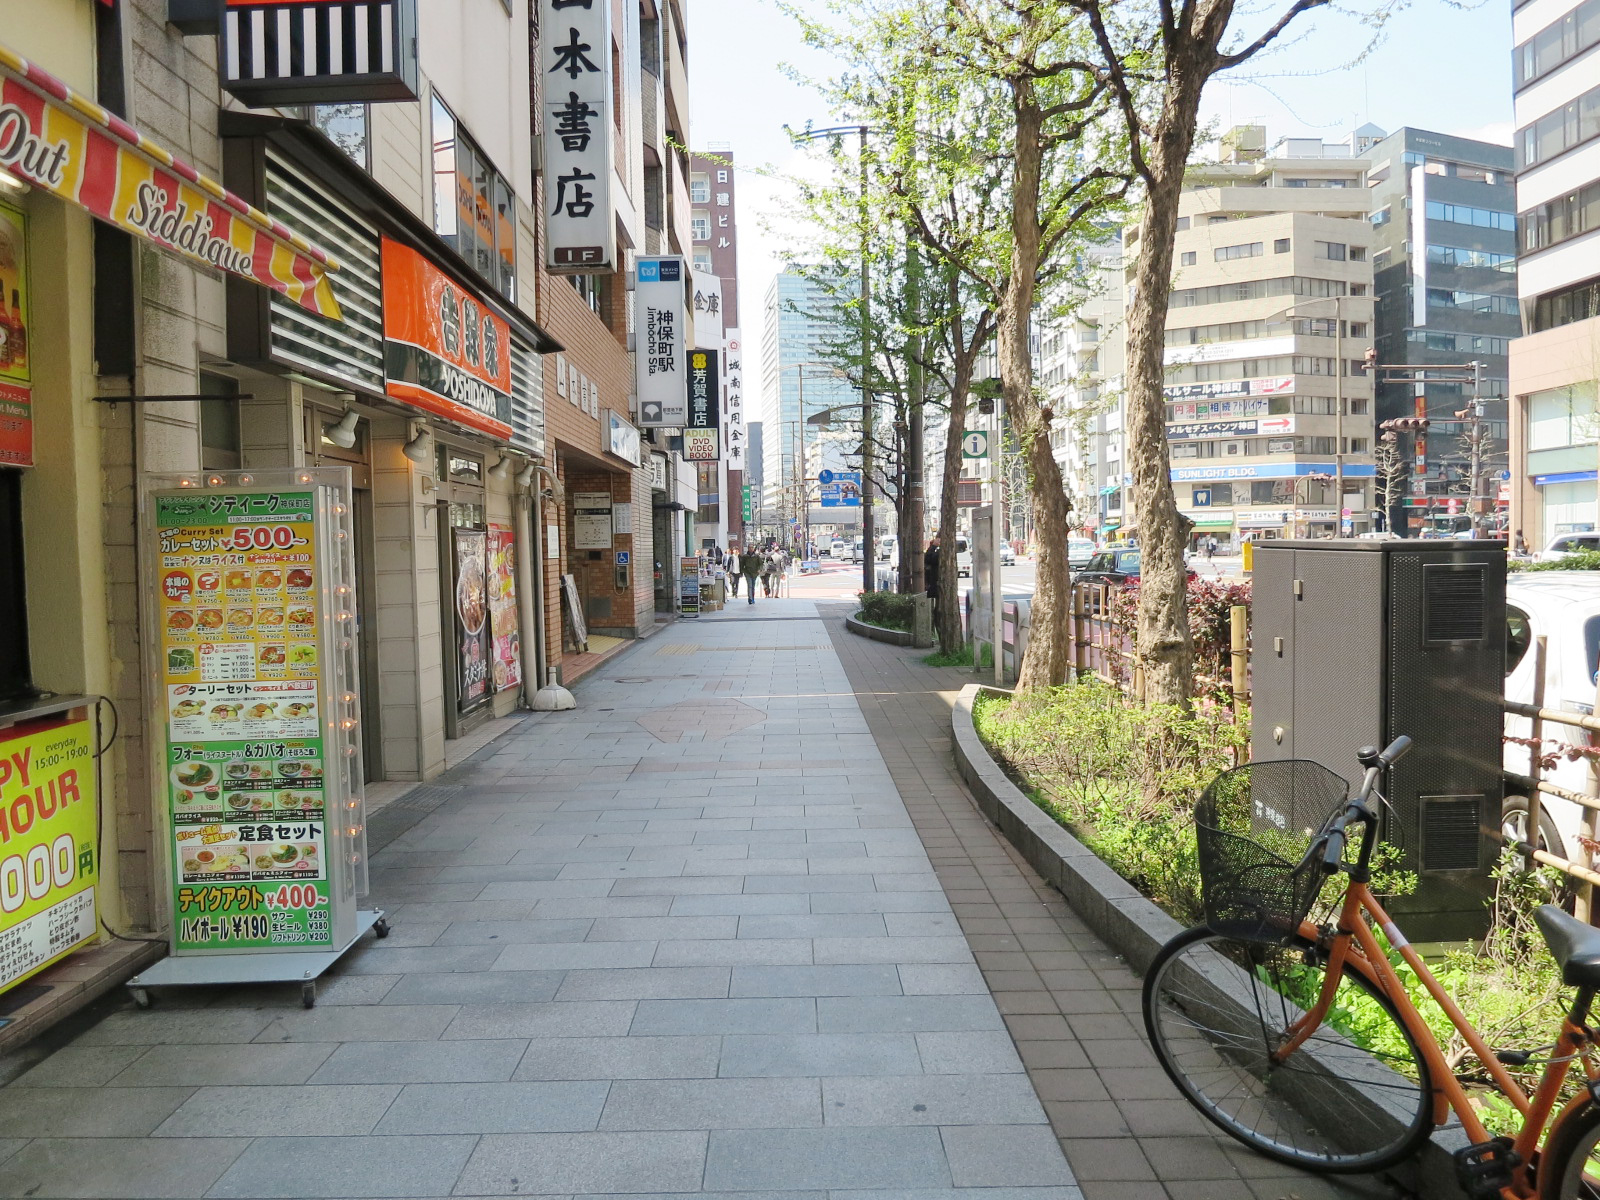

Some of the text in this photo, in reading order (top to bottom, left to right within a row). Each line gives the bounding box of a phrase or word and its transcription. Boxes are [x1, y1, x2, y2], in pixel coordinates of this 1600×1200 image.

[548, 0, 602, 218] 本書店
[0, 107, 67, 185] Out
[716, 170, 731, 249] 日建ビル
[128, 184, 251, 277] Siddique
[694, 289, 719, 318] 金庫
[440, 284, 499, 379] 吉野家
[647, 307, 656, 377] Jimbōchō Sta.
[657, 310, 675, 373] 神保町駅
[443, 367, 498, 416] YOSHINOYA
[692, 369, 708, 427] 芳賀書店
[1163, 383, 1242, 396] ベルサール神保町
[7, 403, 28, 417] Menu
[728, 359, 743, 460] 城南信用金庫
[685, 429, 716, 437] ADULT
[1169, 420, 1256, 434] メルセデス・ベンツ神田
[1178, 467, 1258, 479] SUNLIGHT BLDG.
[280, 498, 311, 508] 神保町店
[180, 528, 206, 536] Curry
[160, 537, 218, 553] カレーセット
[188, 683, 251, 696] ターリーセット
[45, 737, 76, 753] everyday
[173, 747, 203, 760] フォー
[238, 824, 322, 842] 定食セット
[179, 886, 263, 912] テイクアウト
[272, 912, 293, 920] サワー
[181, 915, 268, 941] ハイボール ¥190
[272, 921, 328, 931] 生ビール ¥380
[272, 932, 329, 942] ソフトドリンク ¥200
[1, 953, 46, 983] タンドリーチキン
